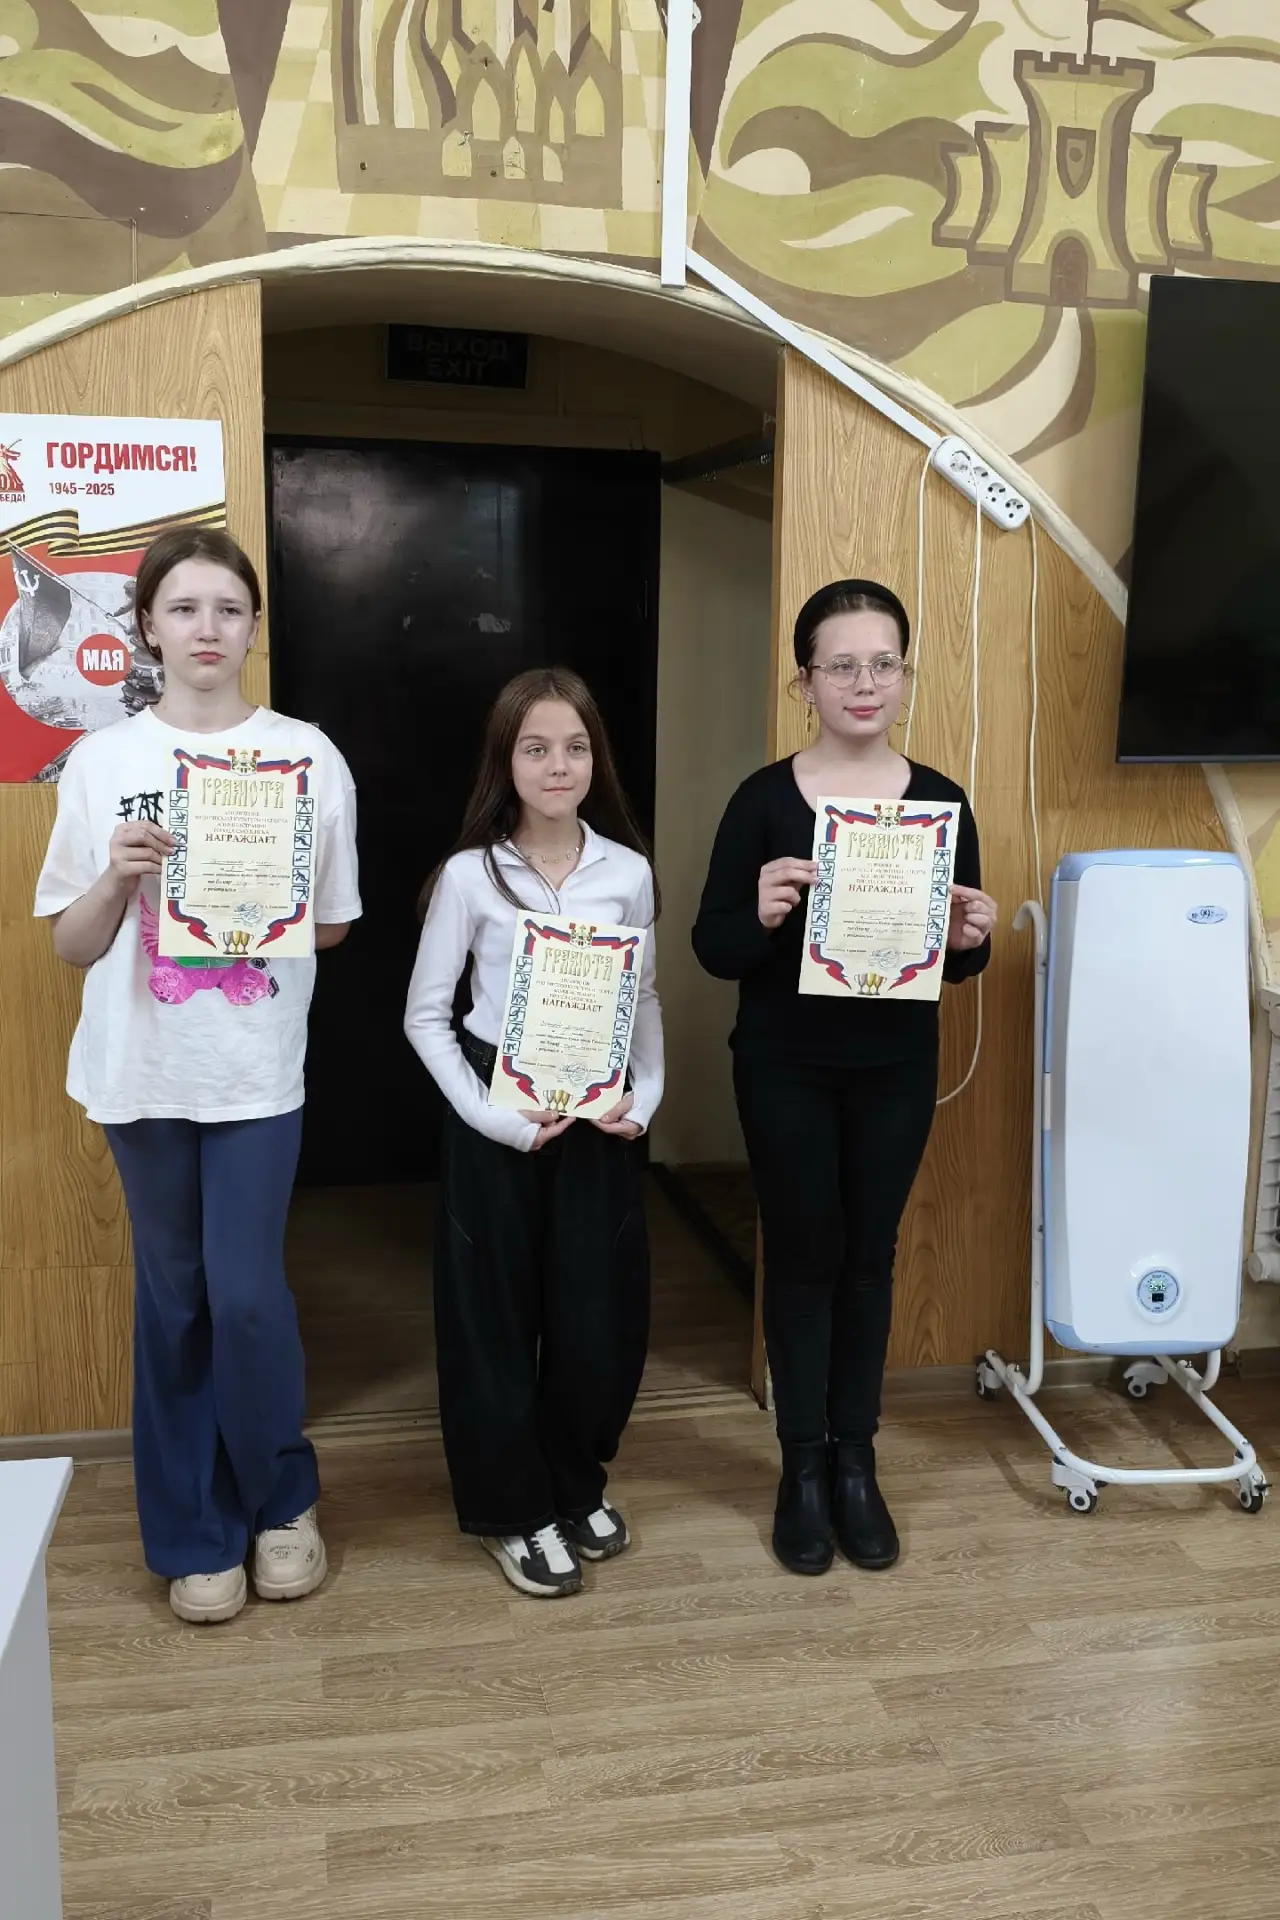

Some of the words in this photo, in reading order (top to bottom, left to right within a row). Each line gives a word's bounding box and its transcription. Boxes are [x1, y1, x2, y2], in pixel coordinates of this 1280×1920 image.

[407, 332, 508, 363] ВЫХОД
[427, 358, 487, 380] EXIT
[46, 442, 197, 474] ГОРДИМСЯ!
[82, 649, 124, 672] МАЯ
[201, 777, 286, 809] ГРАМОТА
[205, 833, 277, 845] НАГРАЖДАЕТ
[848, 884, 915, 894] НАГРАЖДАЕТ
[542, 998, 604, 1012] НАГРАЖДАЕТ
